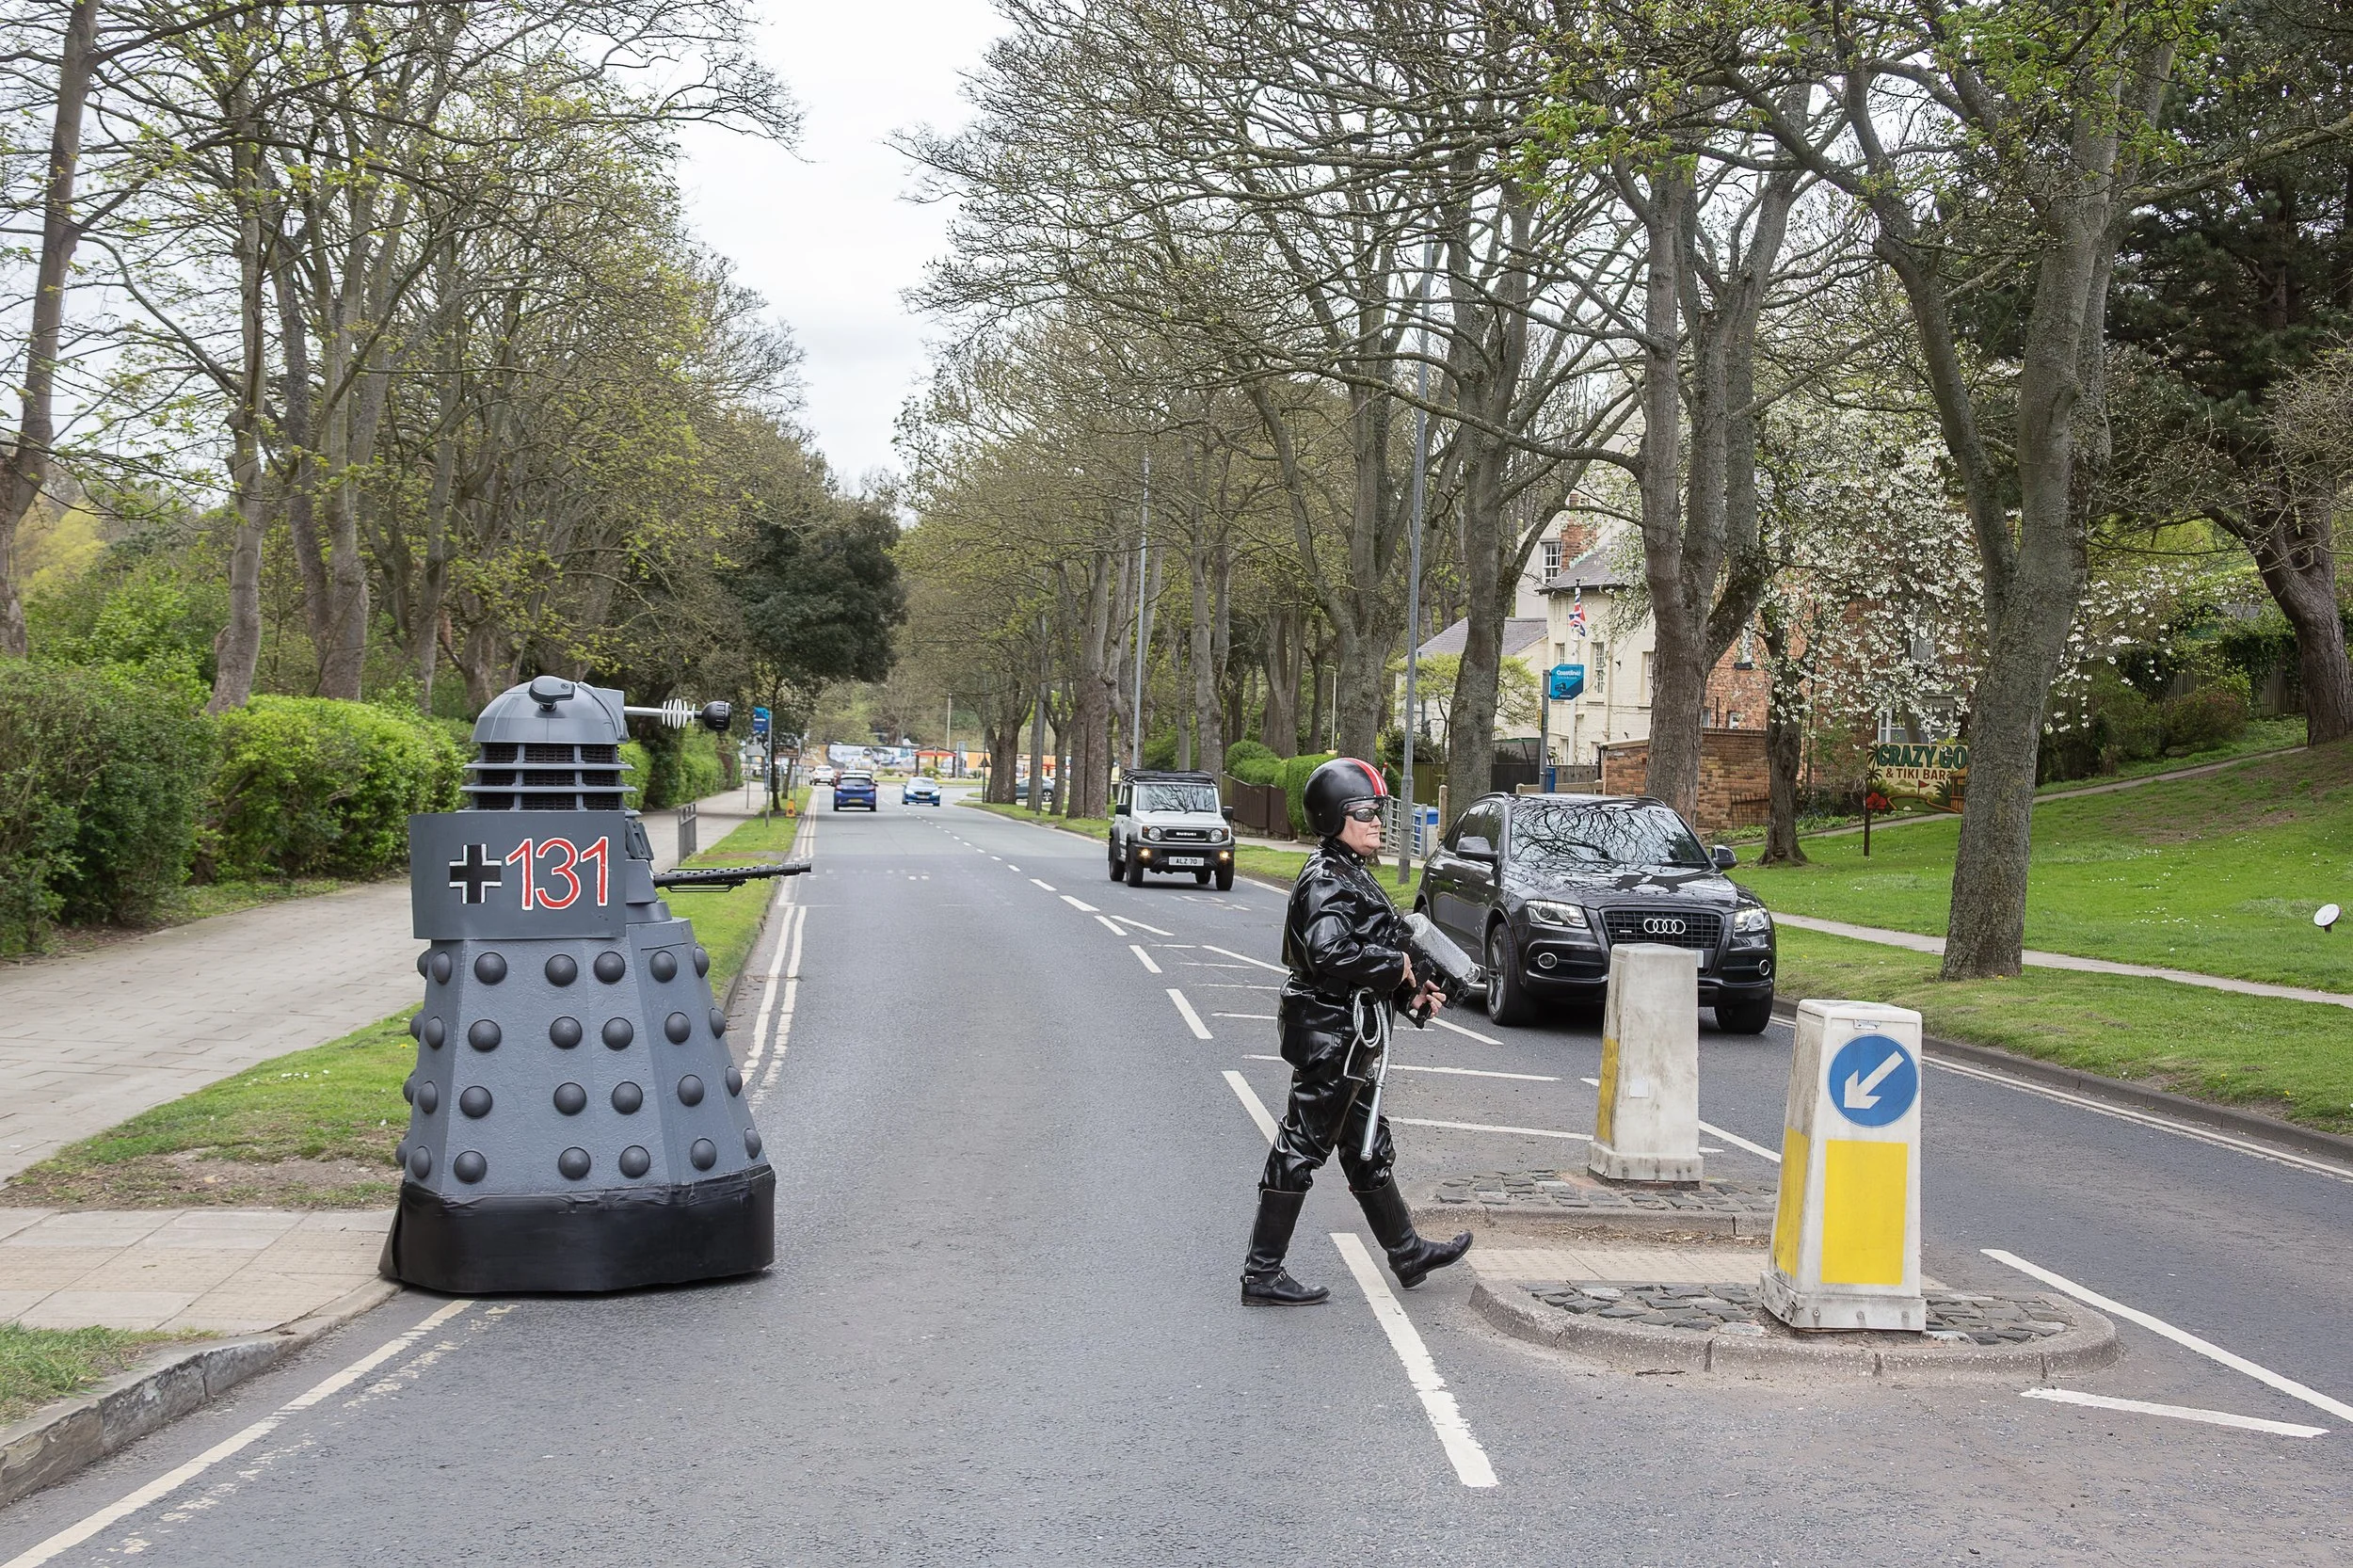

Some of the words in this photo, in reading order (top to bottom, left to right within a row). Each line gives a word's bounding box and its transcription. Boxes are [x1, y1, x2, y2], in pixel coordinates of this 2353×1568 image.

[1877, 744, 1937, 768] CRAZY
[1939, 745, 1967, 770] GO
[1885, 767, 1894, 778] &
[1897, 768, 1919, 779] TIKI
[1923, 769, 1946, 780] BAR
[505, 836, 609, 910] 131
